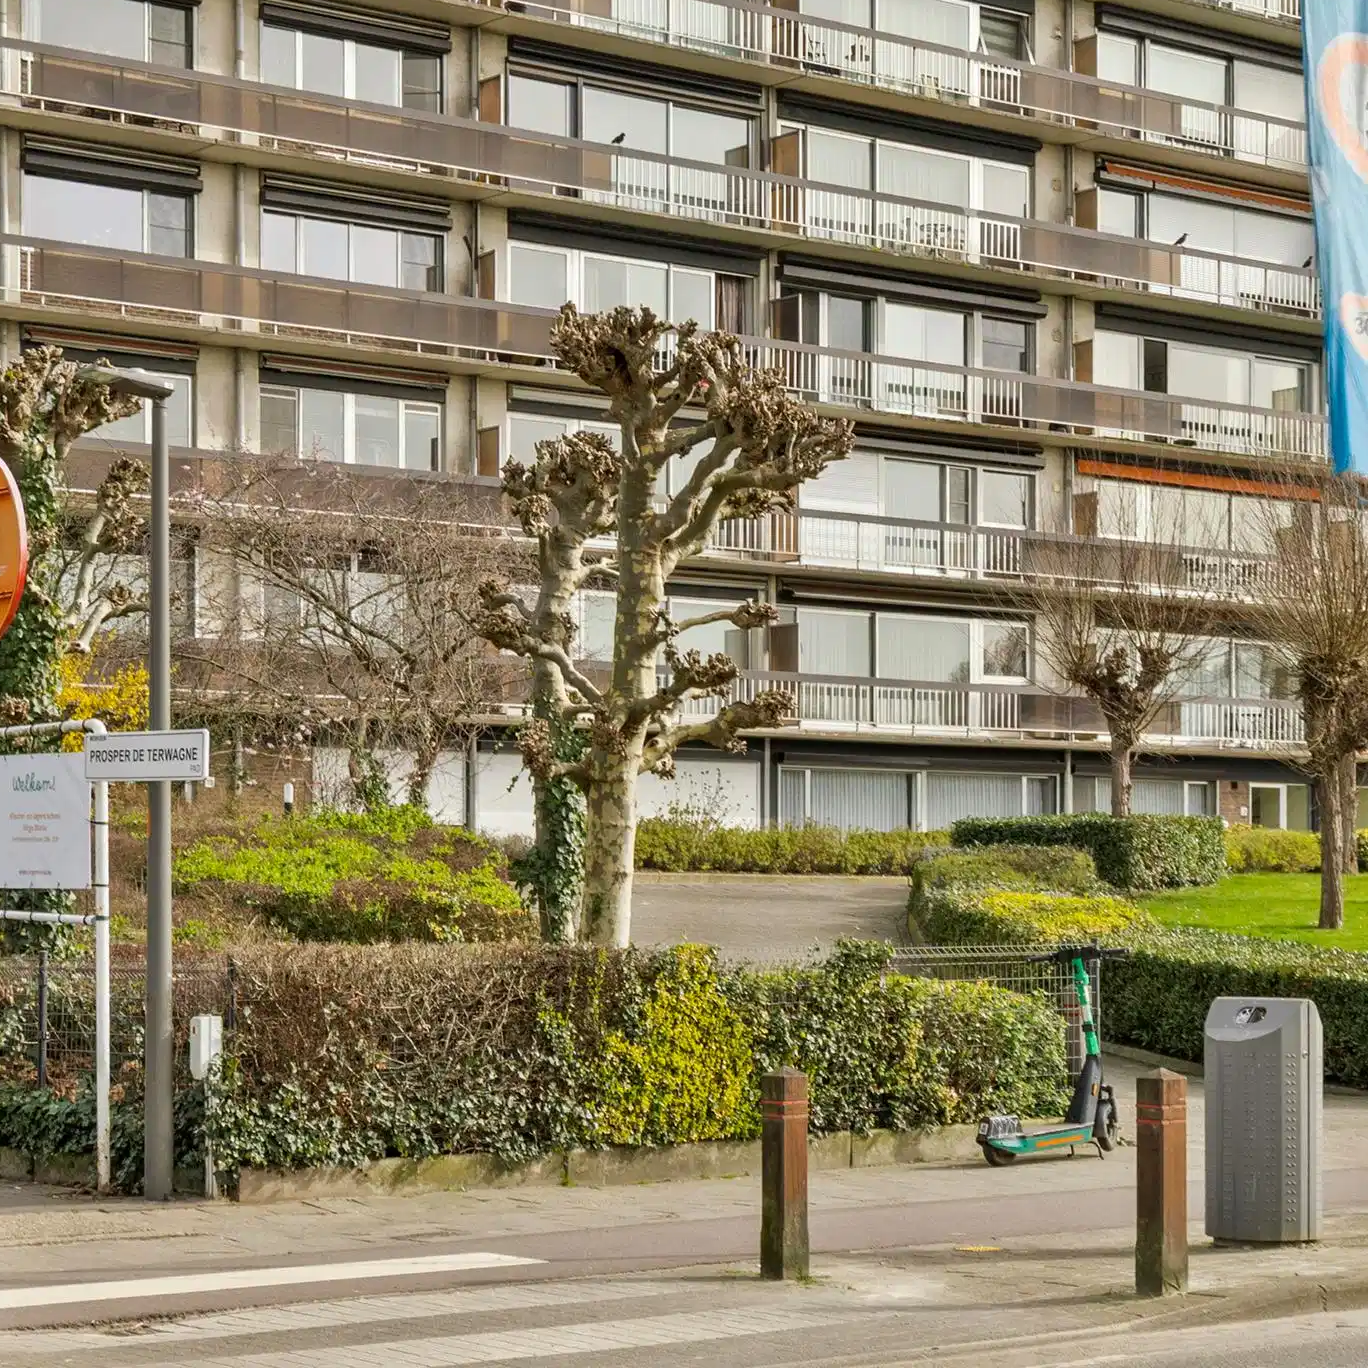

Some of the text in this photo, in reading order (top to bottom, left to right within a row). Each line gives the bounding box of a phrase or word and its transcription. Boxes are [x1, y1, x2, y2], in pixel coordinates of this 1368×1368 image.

[89, 747, 198, 763] PROSPER DE TERWAGNE
[12, 771, 56, 792] Welkom!
